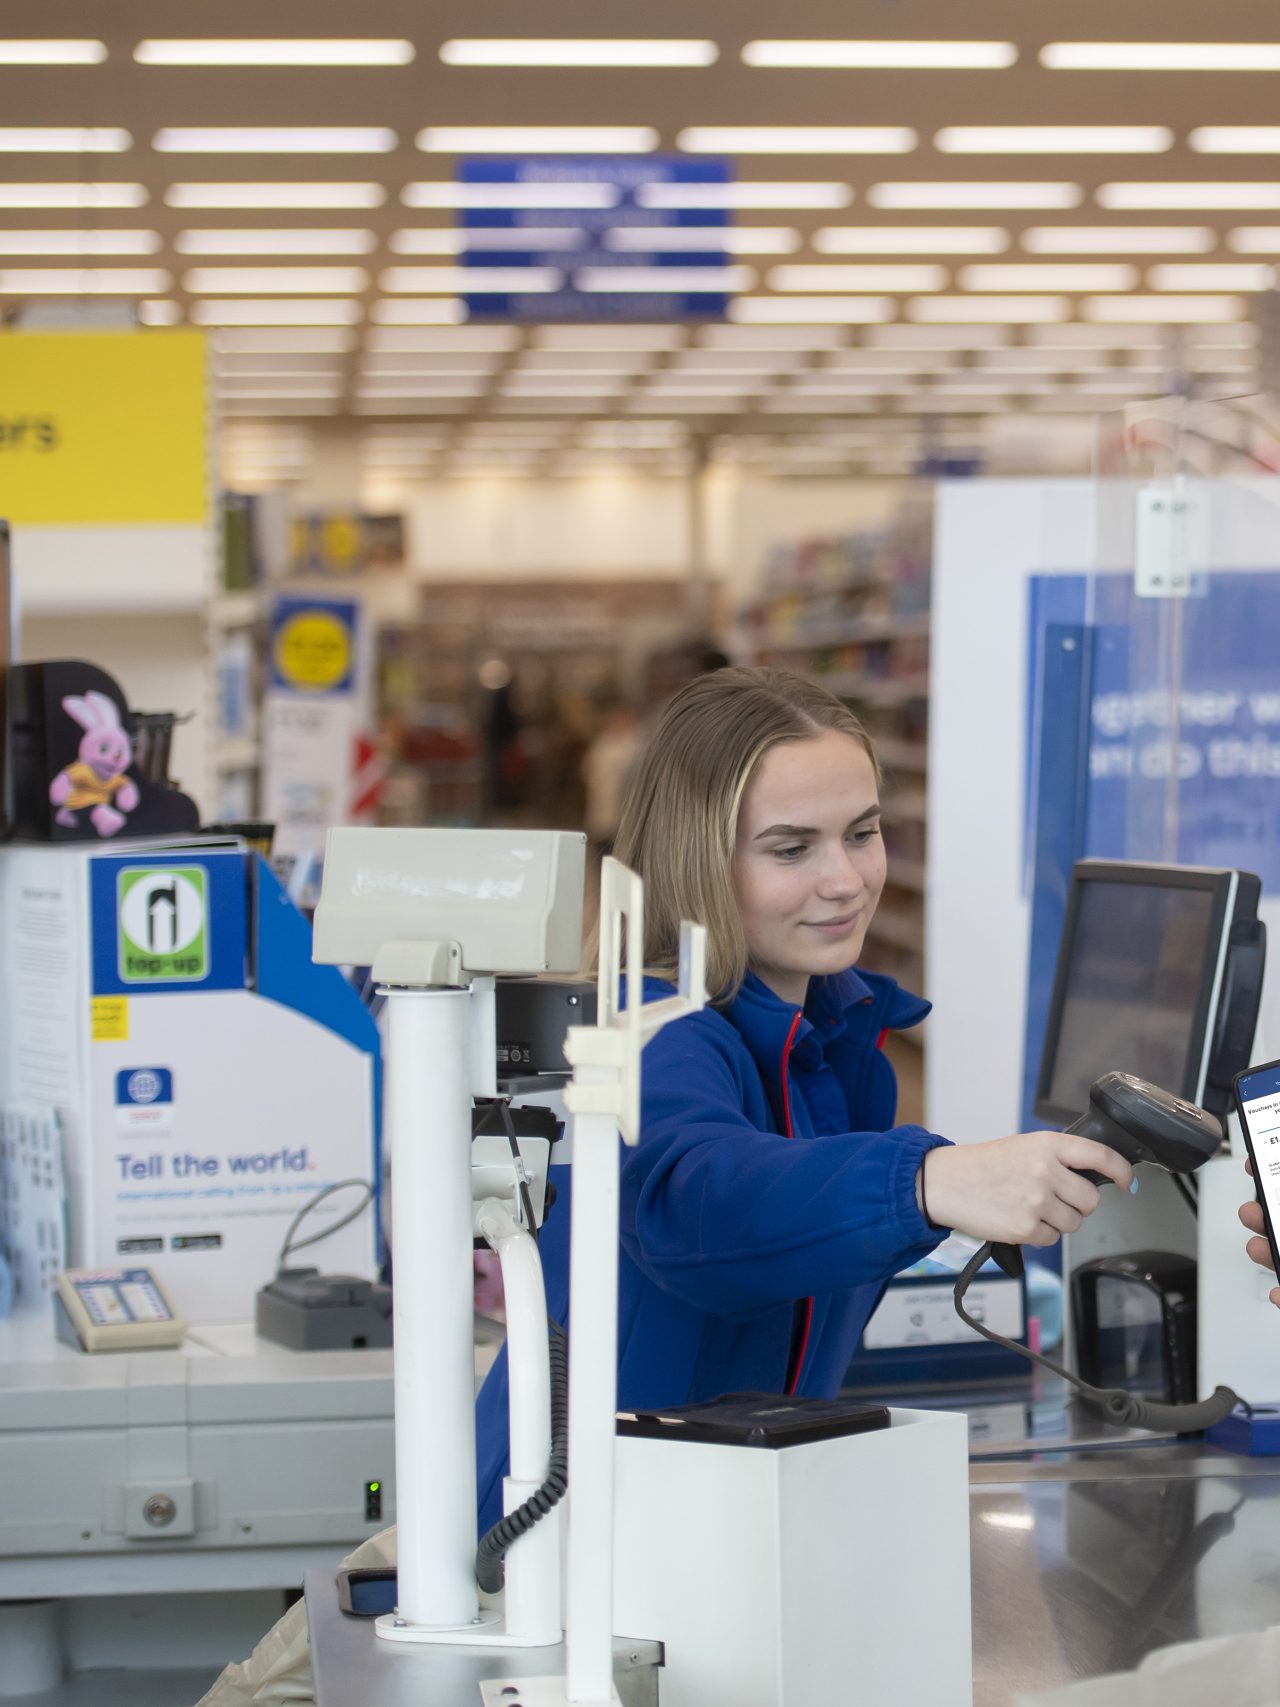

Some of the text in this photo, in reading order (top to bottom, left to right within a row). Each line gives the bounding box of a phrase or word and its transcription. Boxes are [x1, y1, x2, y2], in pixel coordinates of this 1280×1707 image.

[1092, 689, 1241, 737] gether
[1139, 735, 1202, 780] do
[1247, 1104, 1272, 1115] Vouchers
[117, 1148, 317, 1181] Tell the world.
